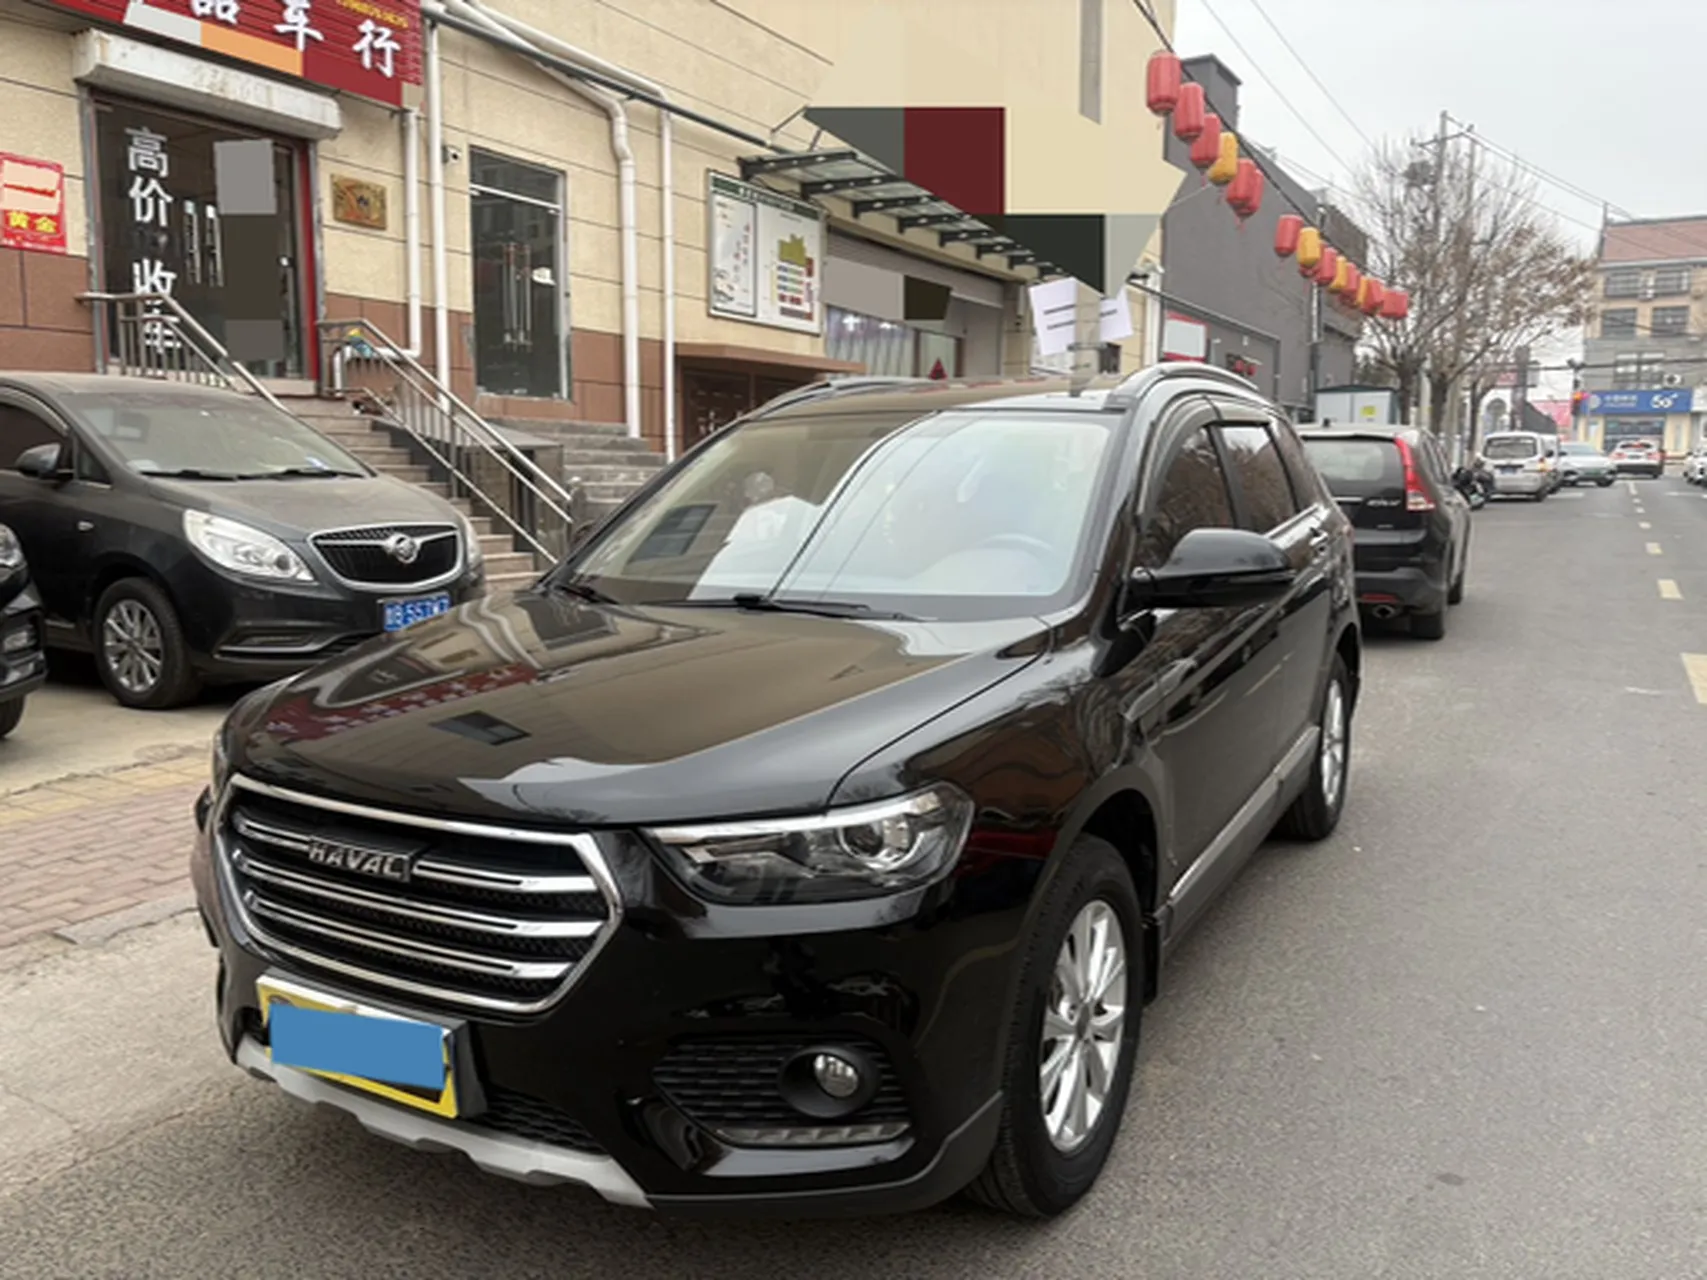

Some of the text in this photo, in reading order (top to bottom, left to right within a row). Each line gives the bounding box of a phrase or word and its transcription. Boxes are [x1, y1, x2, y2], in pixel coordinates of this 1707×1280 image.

[130, 0, 401, 78] 品车行
[308, 842, 402, 879] HAVAL
